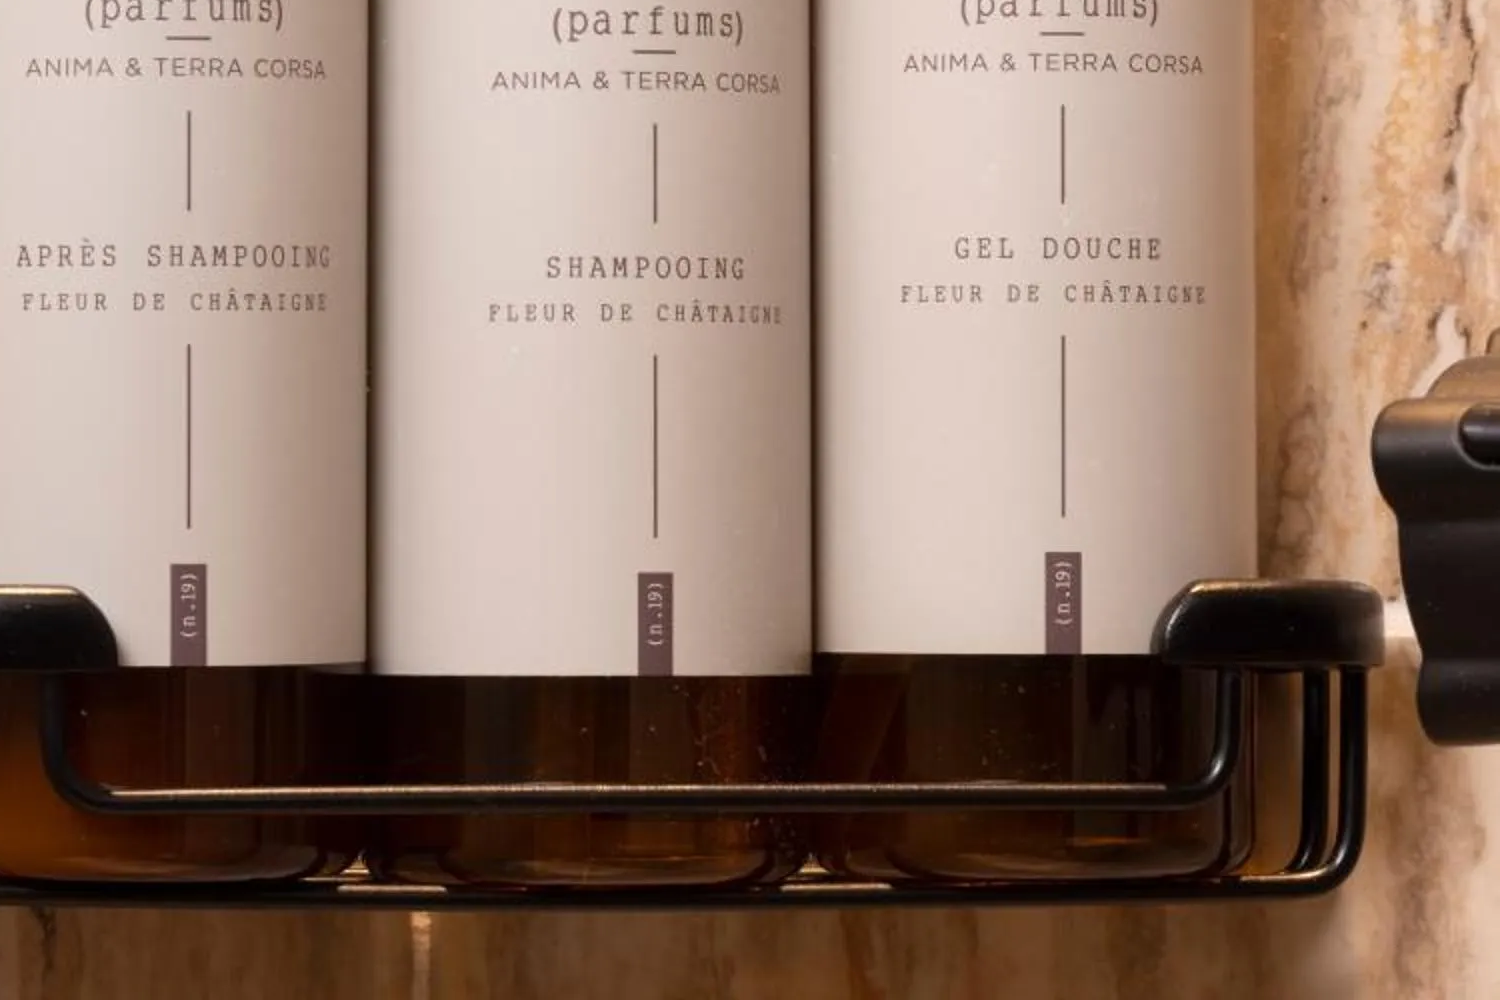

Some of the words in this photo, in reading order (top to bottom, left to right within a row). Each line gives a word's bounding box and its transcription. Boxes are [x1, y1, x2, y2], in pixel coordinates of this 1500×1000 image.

[552, 6, 743, 45] (parfums)
[25, 57, 115, 78] ANIMA
[125, 57, 142, 78] &
[154, 57, 243, 78] TERRA
[254, 58, 326, 79] CORSA
[903, 53, 988, 73] ANIMA
[1000, 54, 1017, 72] &
[1028, 53, 1118, 72] TERRA
[1128, 54, 1203, 74] CORSA
[491, 71, 581, 90] ANIMA
[593, 71, 609, 90] &
[621, 71, 706, 91] TERRA
[716, 72, 780, 94] CORSA
[16, 238, 117, 268] APRÈS
[146, 244, 330, 268] SHAMPOOING
[954, 237, 1014, 260] GEL
[1042, 237, 1161, 260] DOUCHE
[546, 256, 745, 280] SHAMPOOING
[22, 292, 108, 311] FLEUR
[133, 292, 166, 311] DE
[190, 287, 327, 312] CHÂTAIGNE
[900, 285, 983, 304] FLEUR
[1007, 285, 1039, 302] DE
[1065, 280, 1206, 305] CHÂTAIGNE
[488, 304, 576, 322] FLEUR
[600, 304, 632, 322] DE
[656, 299, 781, 325] CHÂTAIGNE
[180, 573, 198, 637] (n.19)
[1055, 562, 1072, 625] (n.19)
[648, 583, 664, 646] (n.19)
